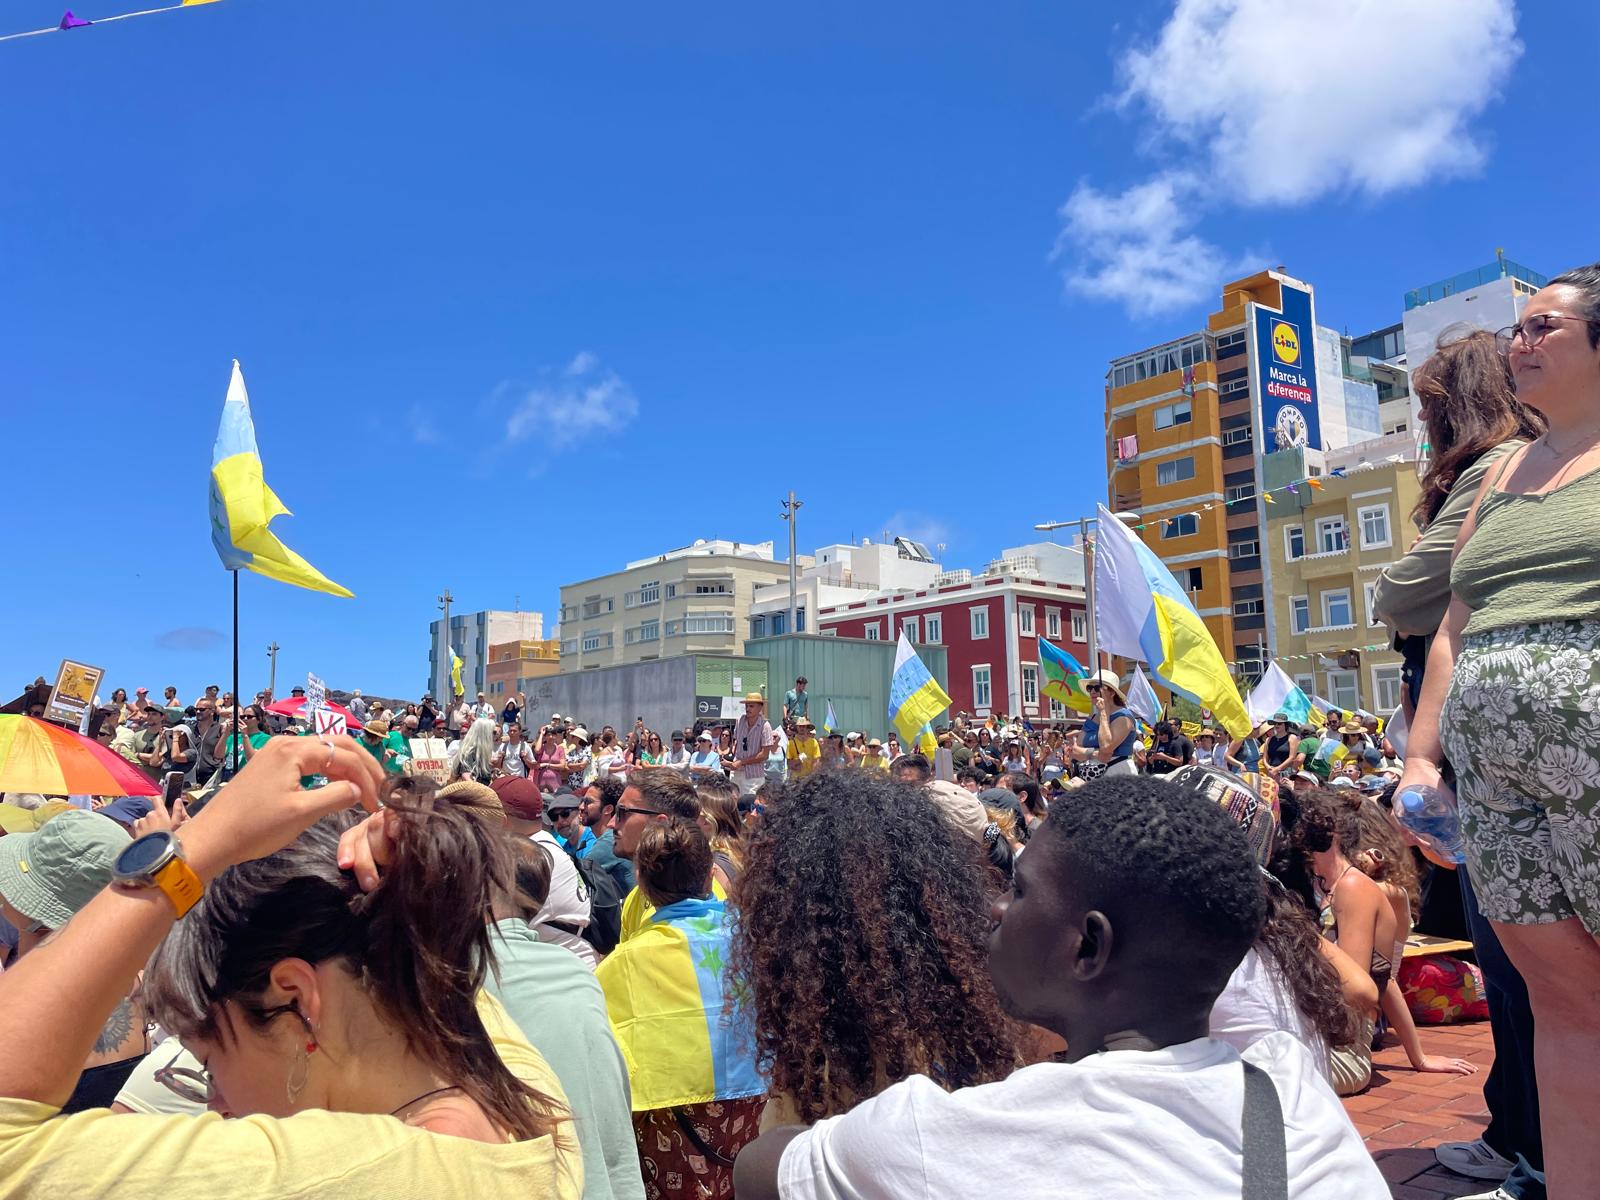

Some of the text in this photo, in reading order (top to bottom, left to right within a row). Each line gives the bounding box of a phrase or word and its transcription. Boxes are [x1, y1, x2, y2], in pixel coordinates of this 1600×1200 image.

[1269, 366, 1307, 387] Marca la
[1280, 409, 1304, 429] COMPRO
[416, 760, 443, 770] PUEBLO
